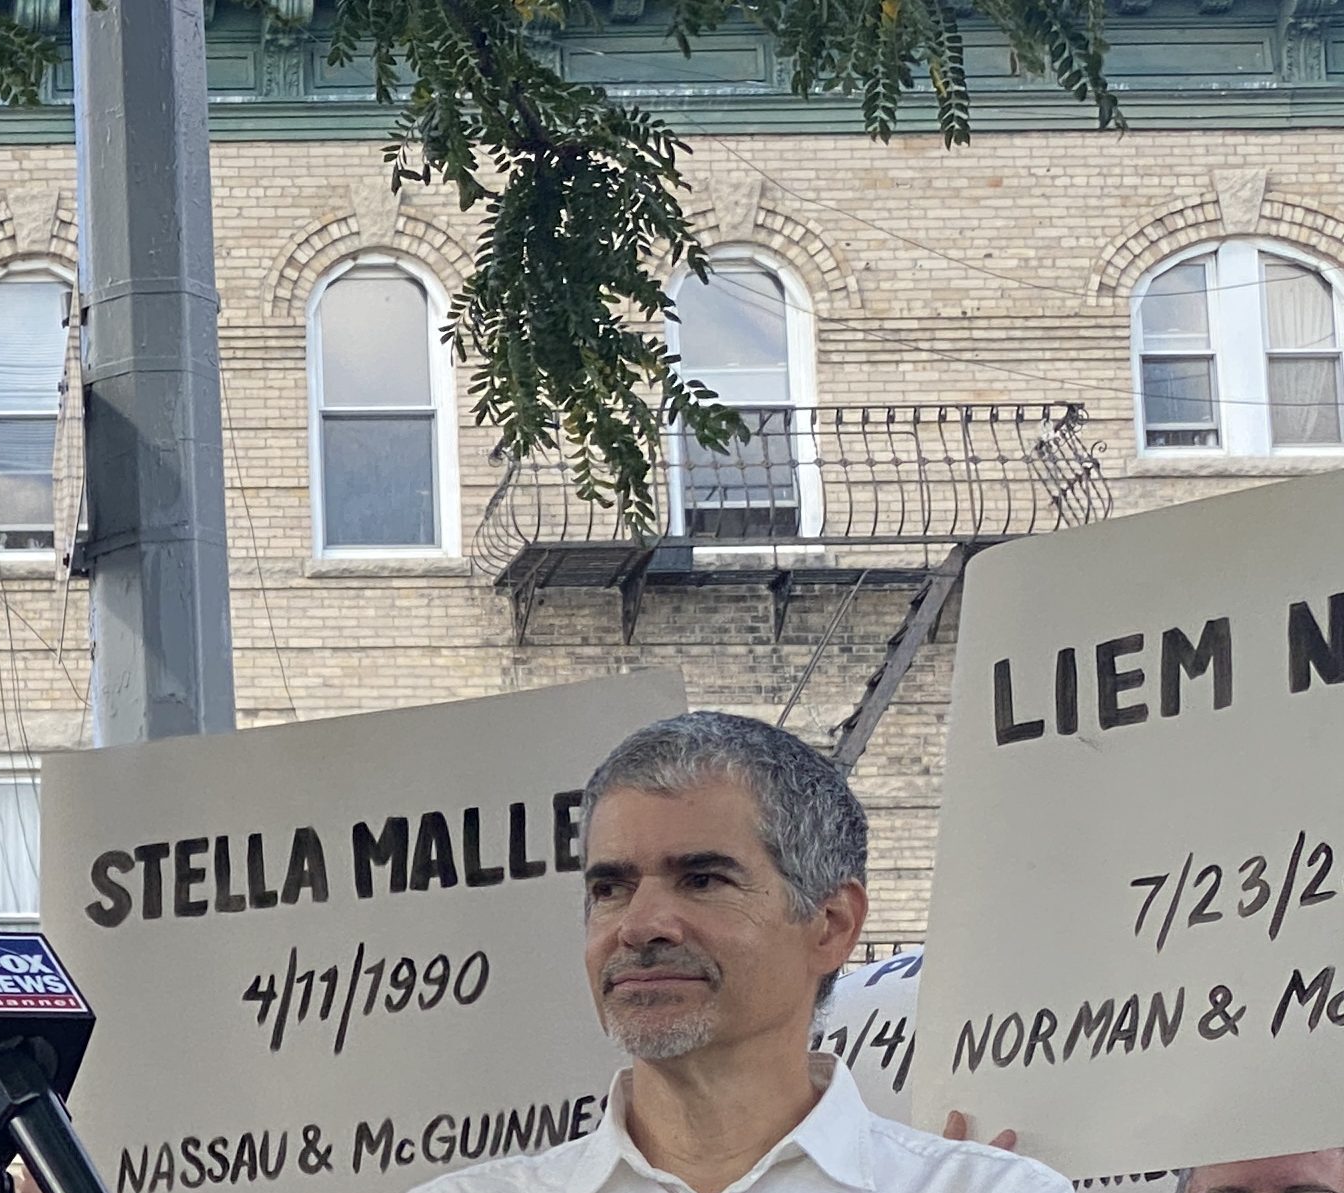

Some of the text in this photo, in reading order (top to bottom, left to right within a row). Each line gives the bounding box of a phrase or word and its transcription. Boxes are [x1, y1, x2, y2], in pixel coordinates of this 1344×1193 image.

[994, 617, 1232, 746] LIEM
[85, 826, 329, 928] STELLA
[242, 943, 489, 1055] 4/11/1990
[952, 986, 1185, 1076] NORMAN
[1198, 984, 1247, 1041] &
[299, 1124, 333, 1175] &
